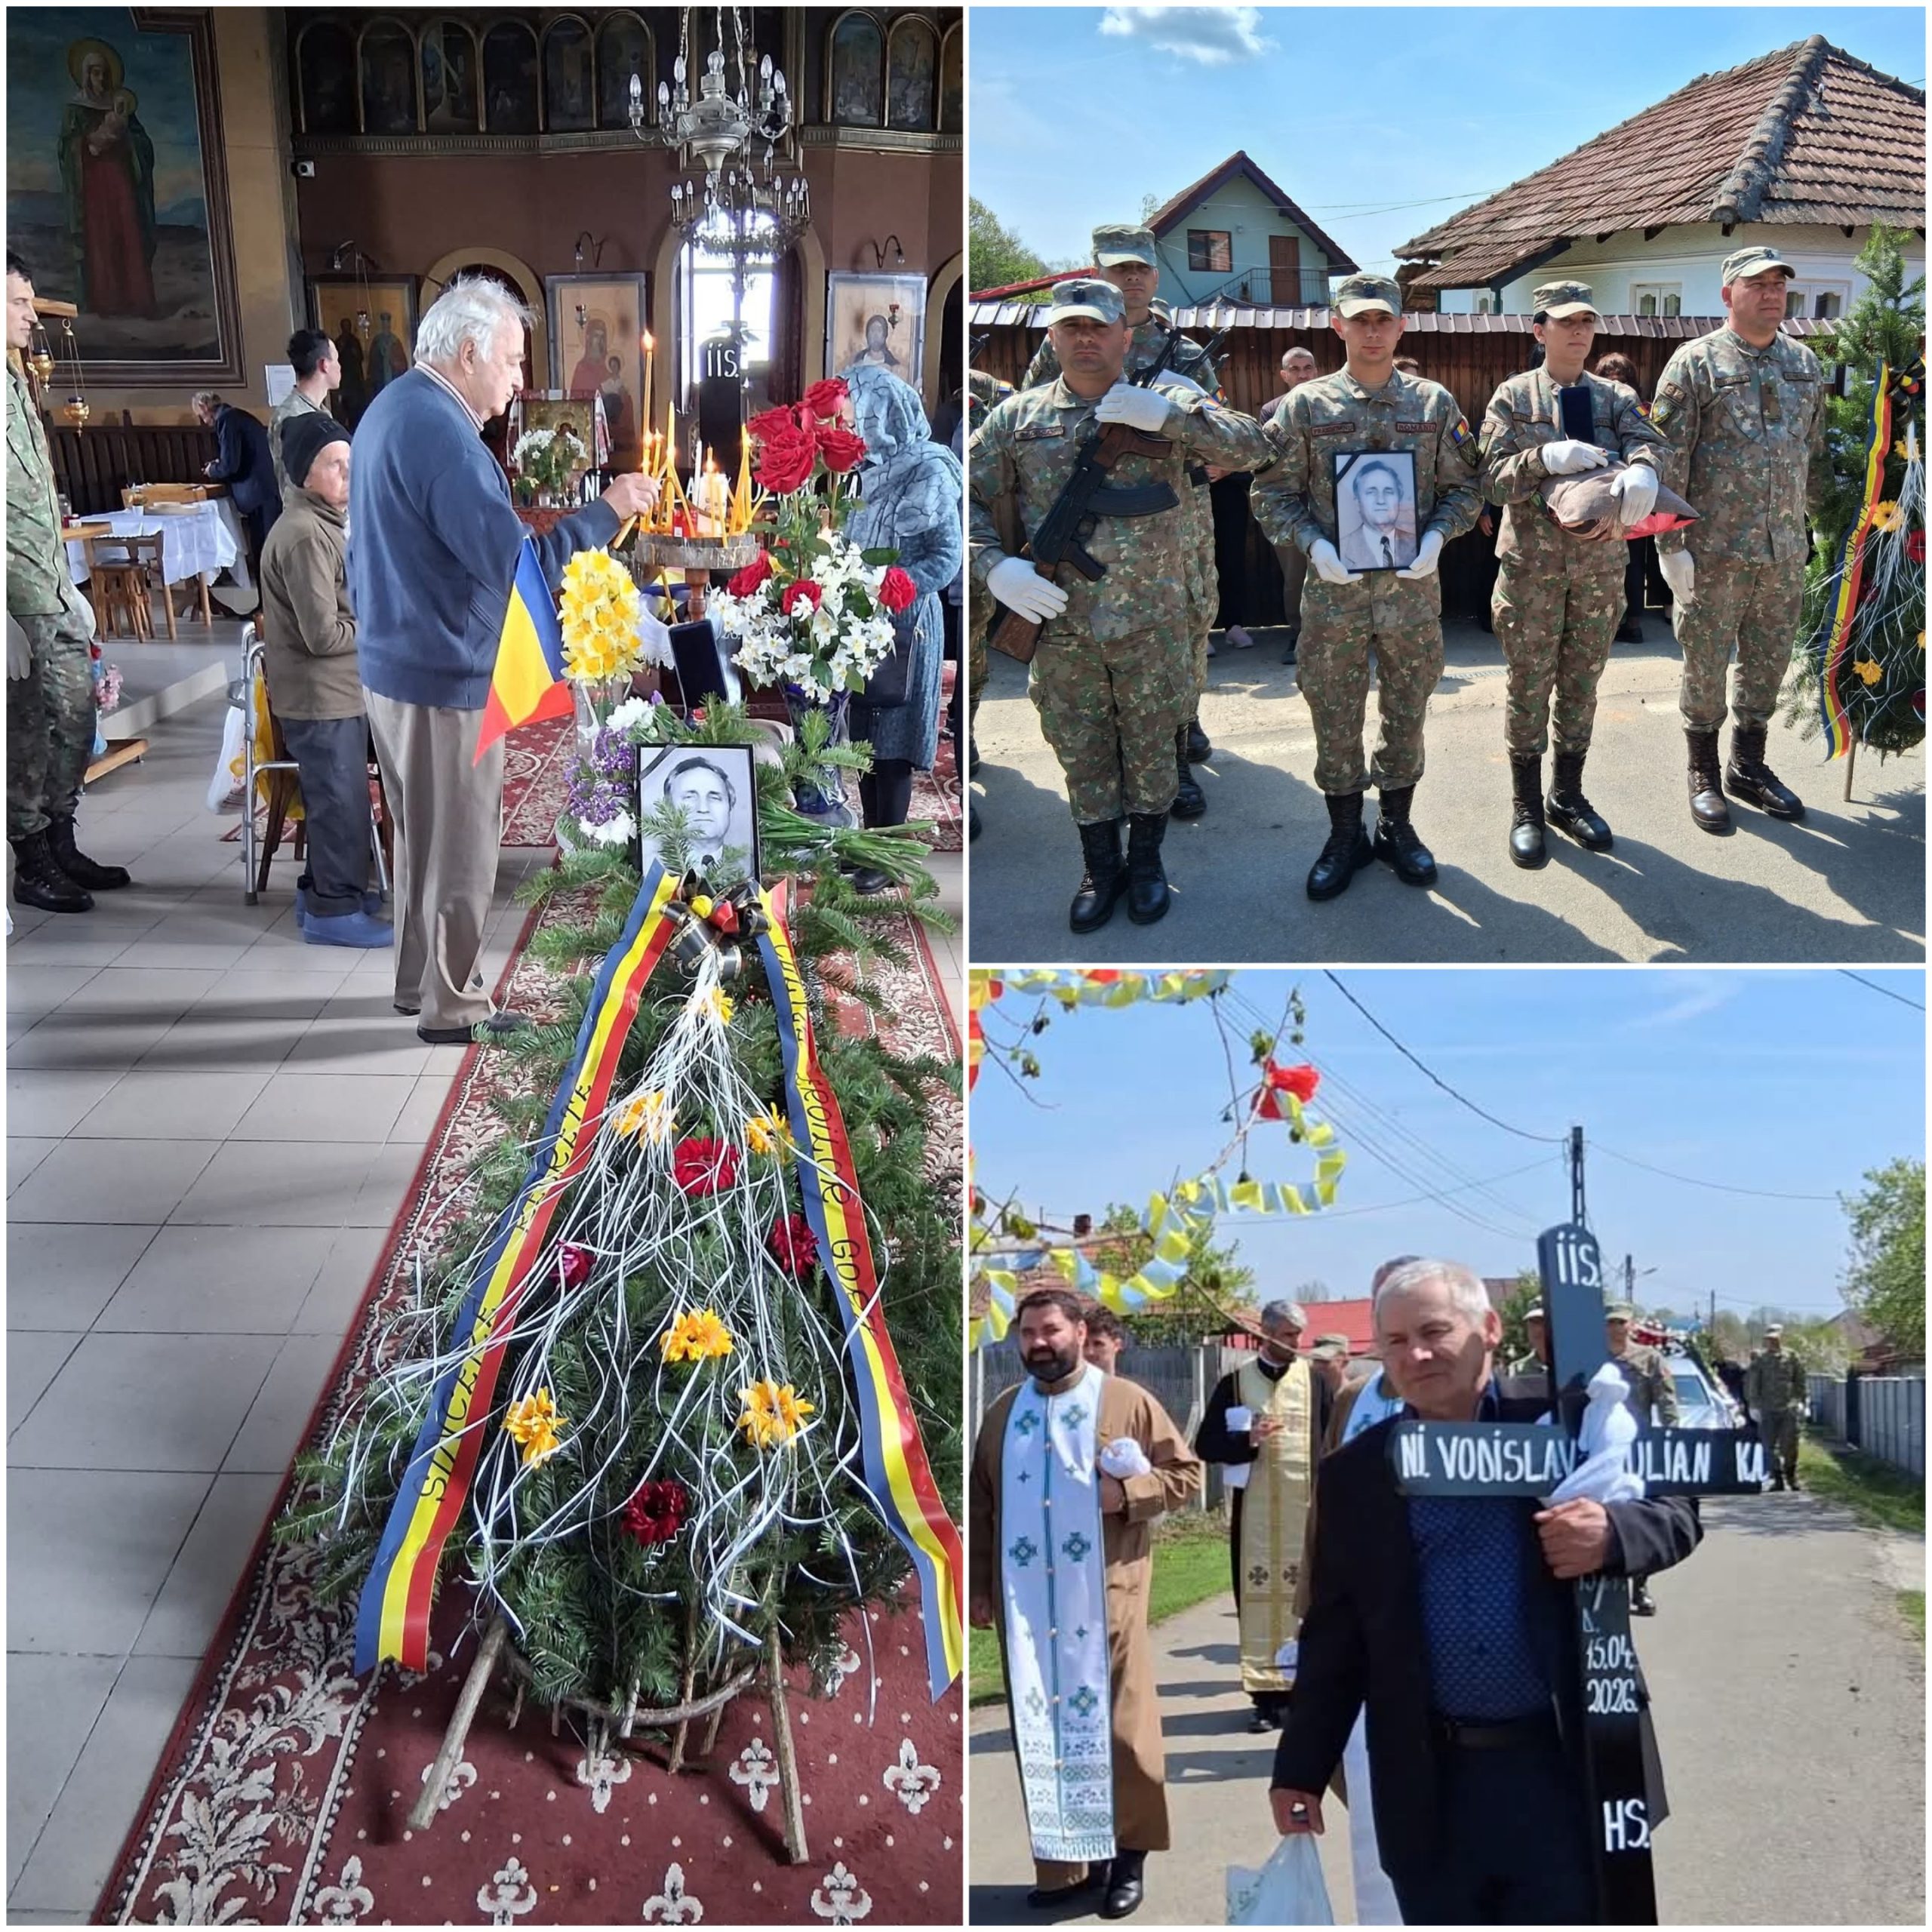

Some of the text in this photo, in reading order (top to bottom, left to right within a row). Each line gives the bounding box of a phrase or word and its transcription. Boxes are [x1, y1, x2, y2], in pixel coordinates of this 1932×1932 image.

[795, 1072, 850, 1205] EROILOR
[1622, 1430, 1711, 1483] ULIAN
[1603, 1799, 1651, 1852] HS.
